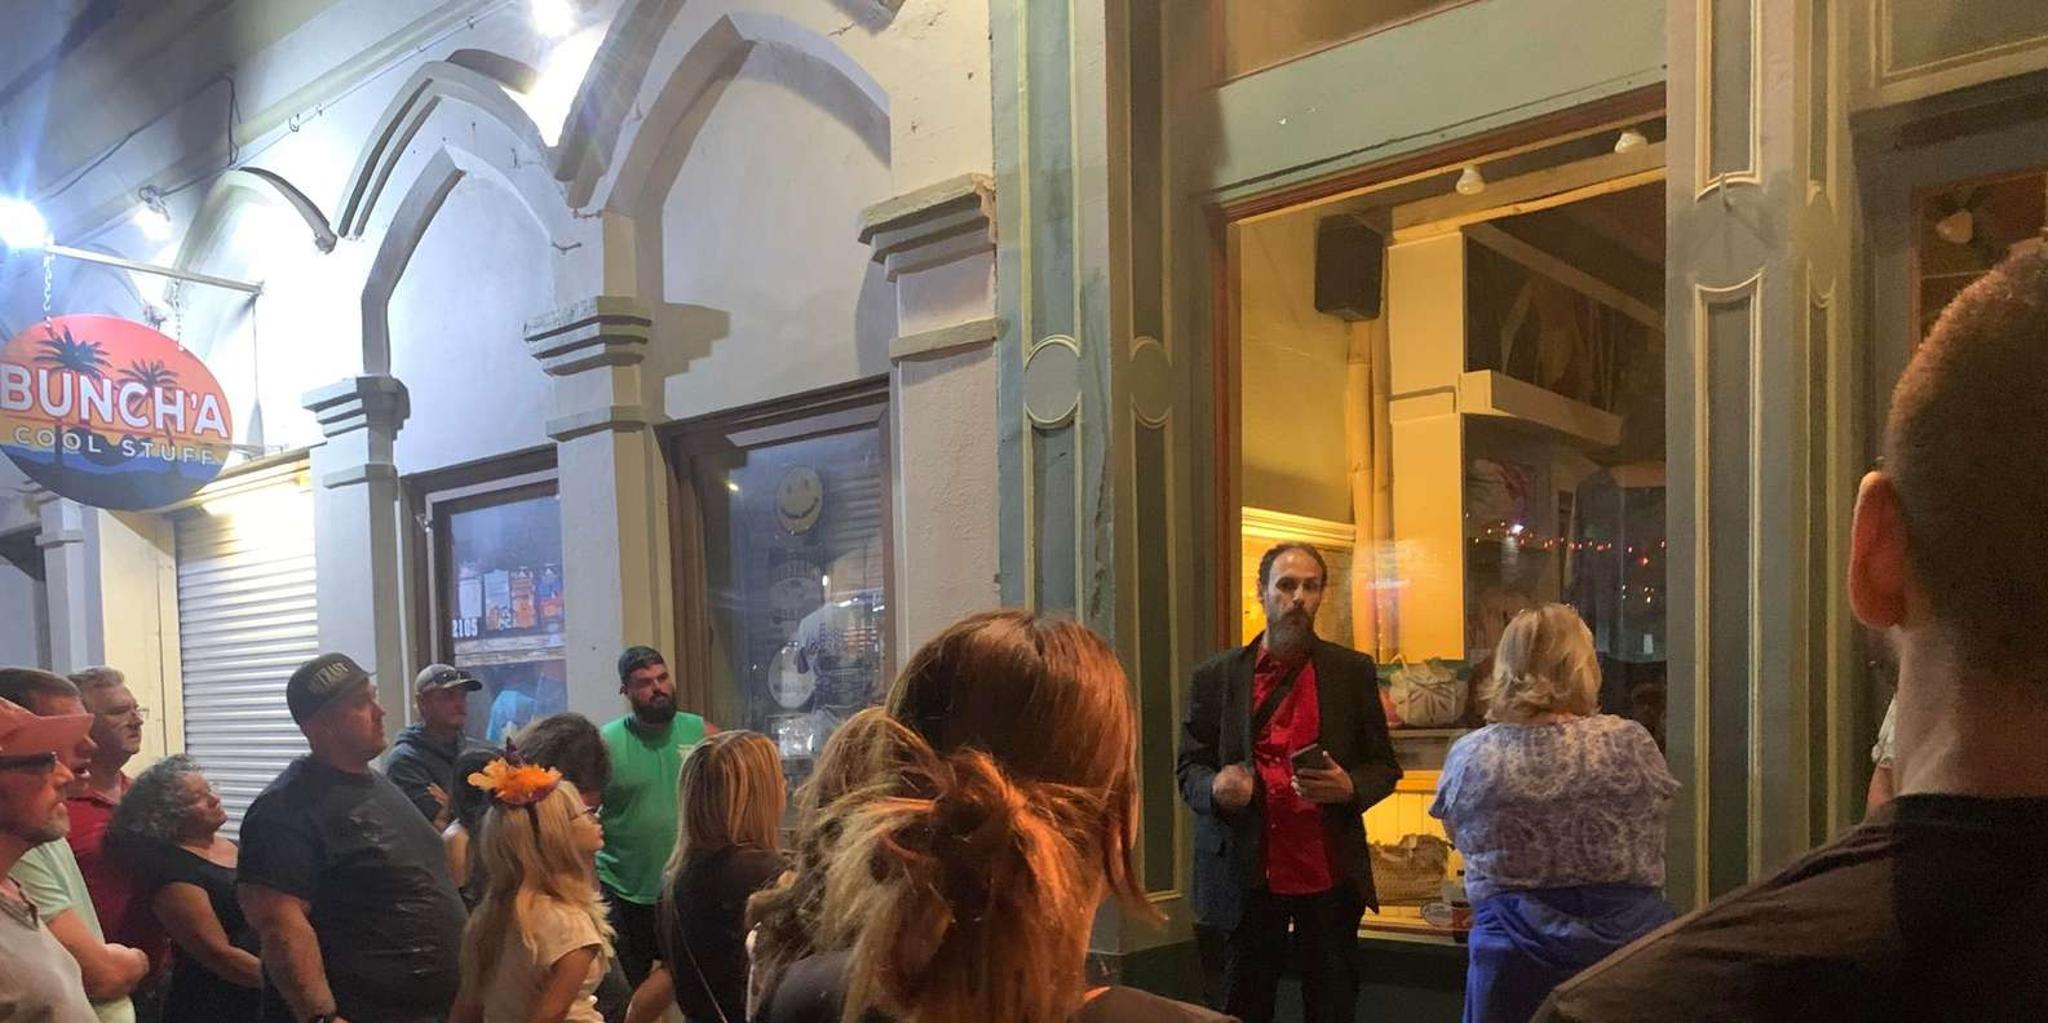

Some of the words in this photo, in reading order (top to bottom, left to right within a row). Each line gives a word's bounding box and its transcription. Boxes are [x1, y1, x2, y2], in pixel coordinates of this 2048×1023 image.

[0, 363, 228, 437] BUNCH'A
[15, 426, 102, 453] COOL
[122, 439, 213, 465] STUFF
